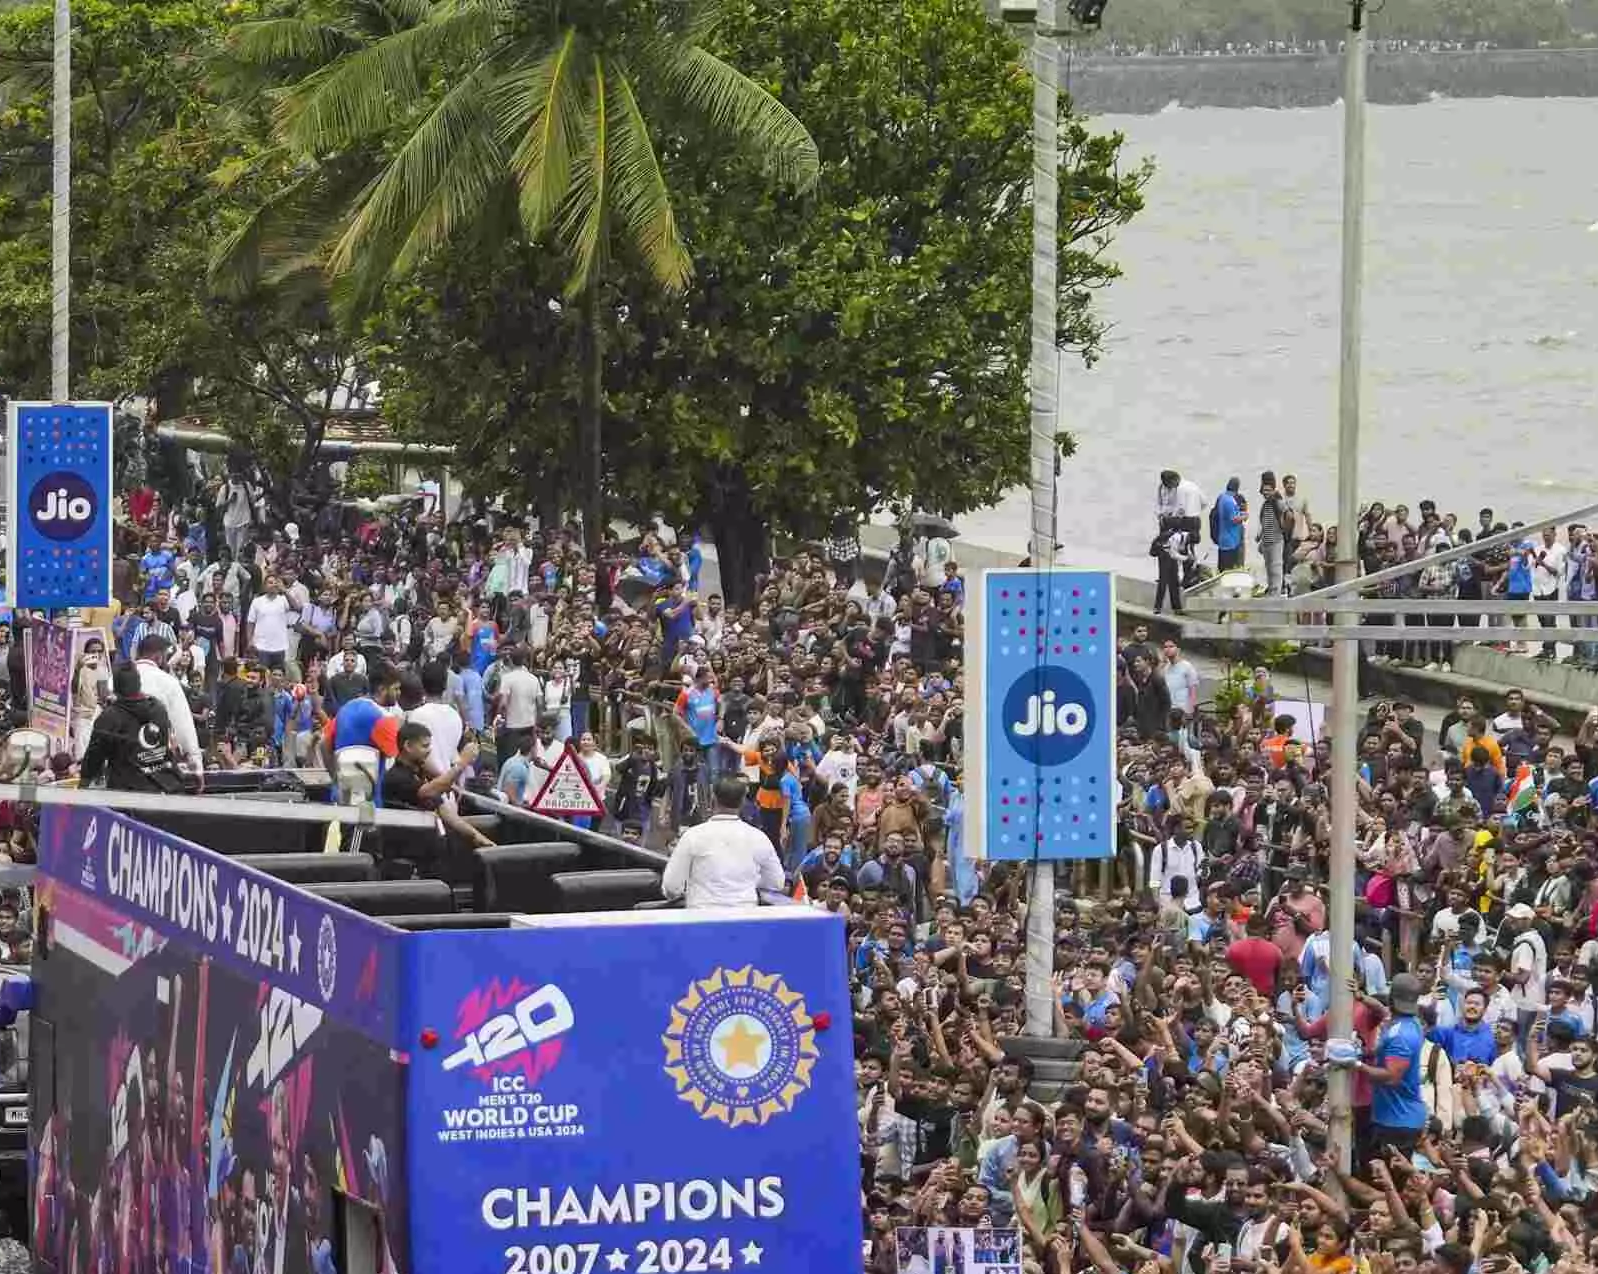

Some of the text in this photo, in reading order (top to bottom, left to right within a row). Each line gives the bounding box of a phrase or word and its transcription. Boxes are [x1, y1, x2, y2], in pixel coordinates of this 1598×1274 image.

[36, 488, 92, 521] Jio
[1013, 690, 1087, 737] Jio
[107, 821, 285, 974] CHAMPIONS 2024
[478, 1093, 542, 1107] MEN'S T20
[492, 1075, 527, 1093] ICC
[444, 1104, 579, 1127] WORLD CUP
[437, 1130, 473, 1142] WEST
[476, 1128, 515, 1141] INDIES
[529, 1126, 553, 1138] USA
[555, 1124, 585, 1136] 2024
[481, 1176, 786, 1230] CHAMPIONS
[635, 1236, 733, 1274] 2024
